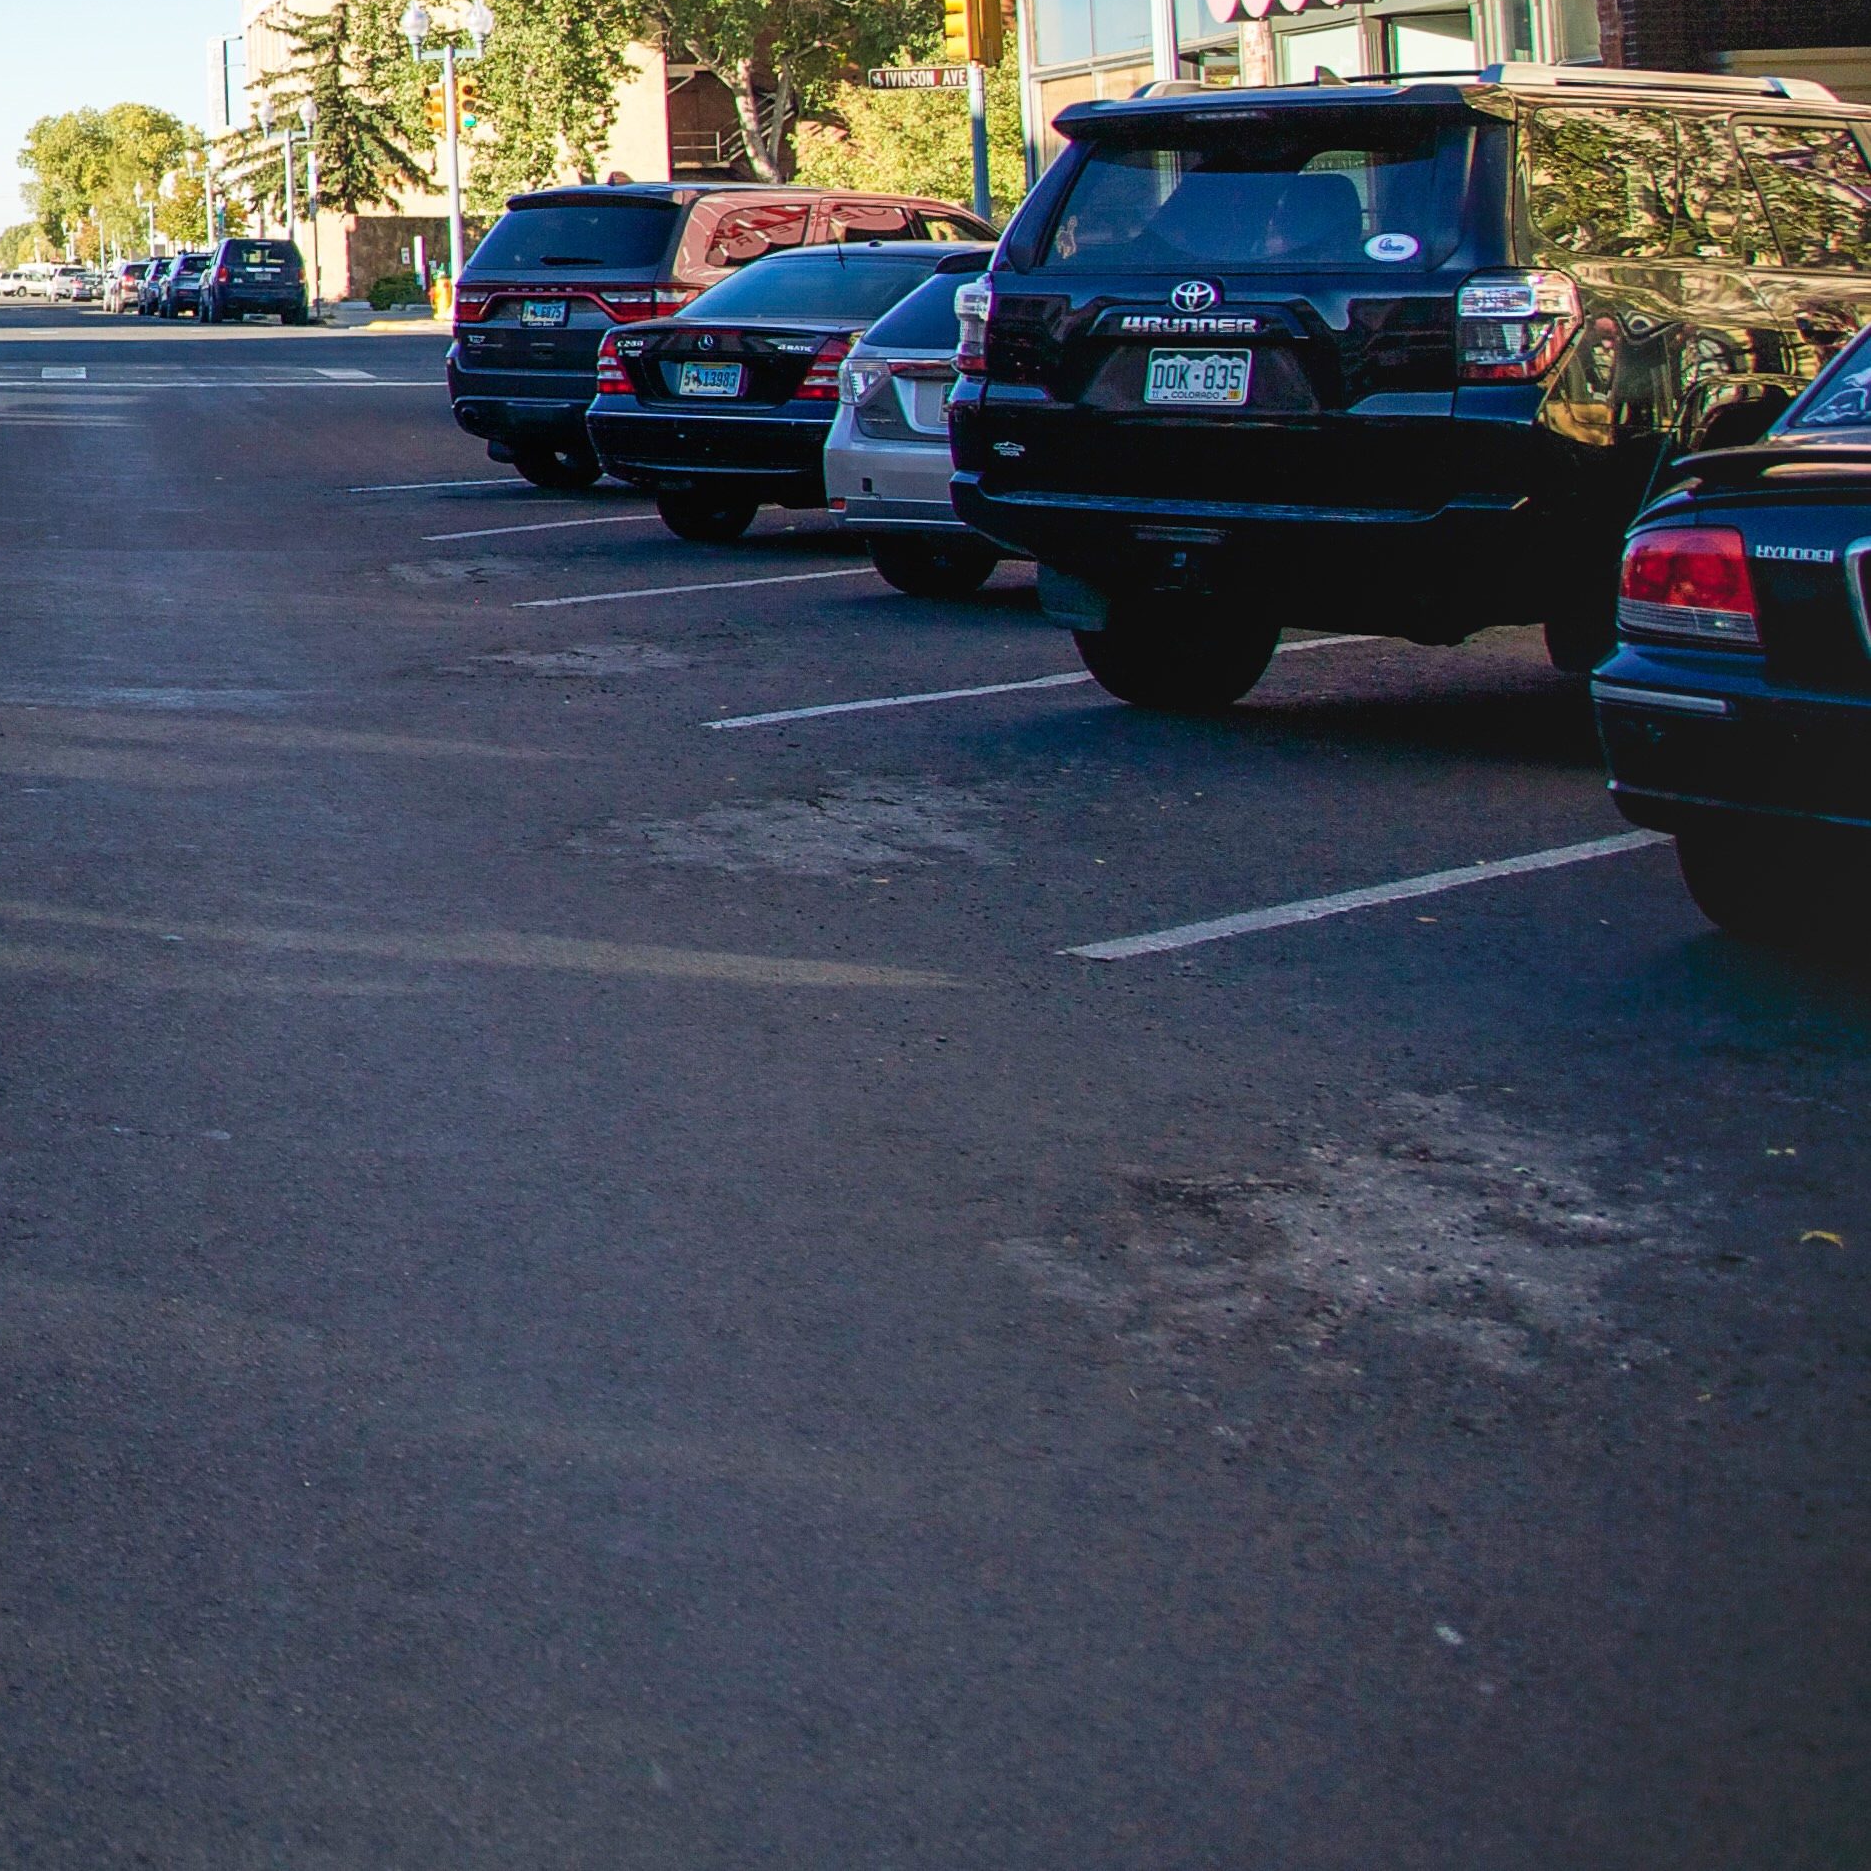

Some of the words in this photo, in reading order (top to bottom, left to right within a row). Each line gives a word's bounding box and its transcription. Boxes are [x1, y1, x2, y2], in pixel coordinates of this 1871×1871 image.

[885, 70, 935, 87] IVINSON
[942, 69, 966, 86] AVE
[1121, 316, 1257, 333] 4RUNNER
[777, 344, 813, 353] 4MATIC
[1170, 390, 1220, 399] COLORADO
[1755, 544, 1833, 563] HYUNDAI
